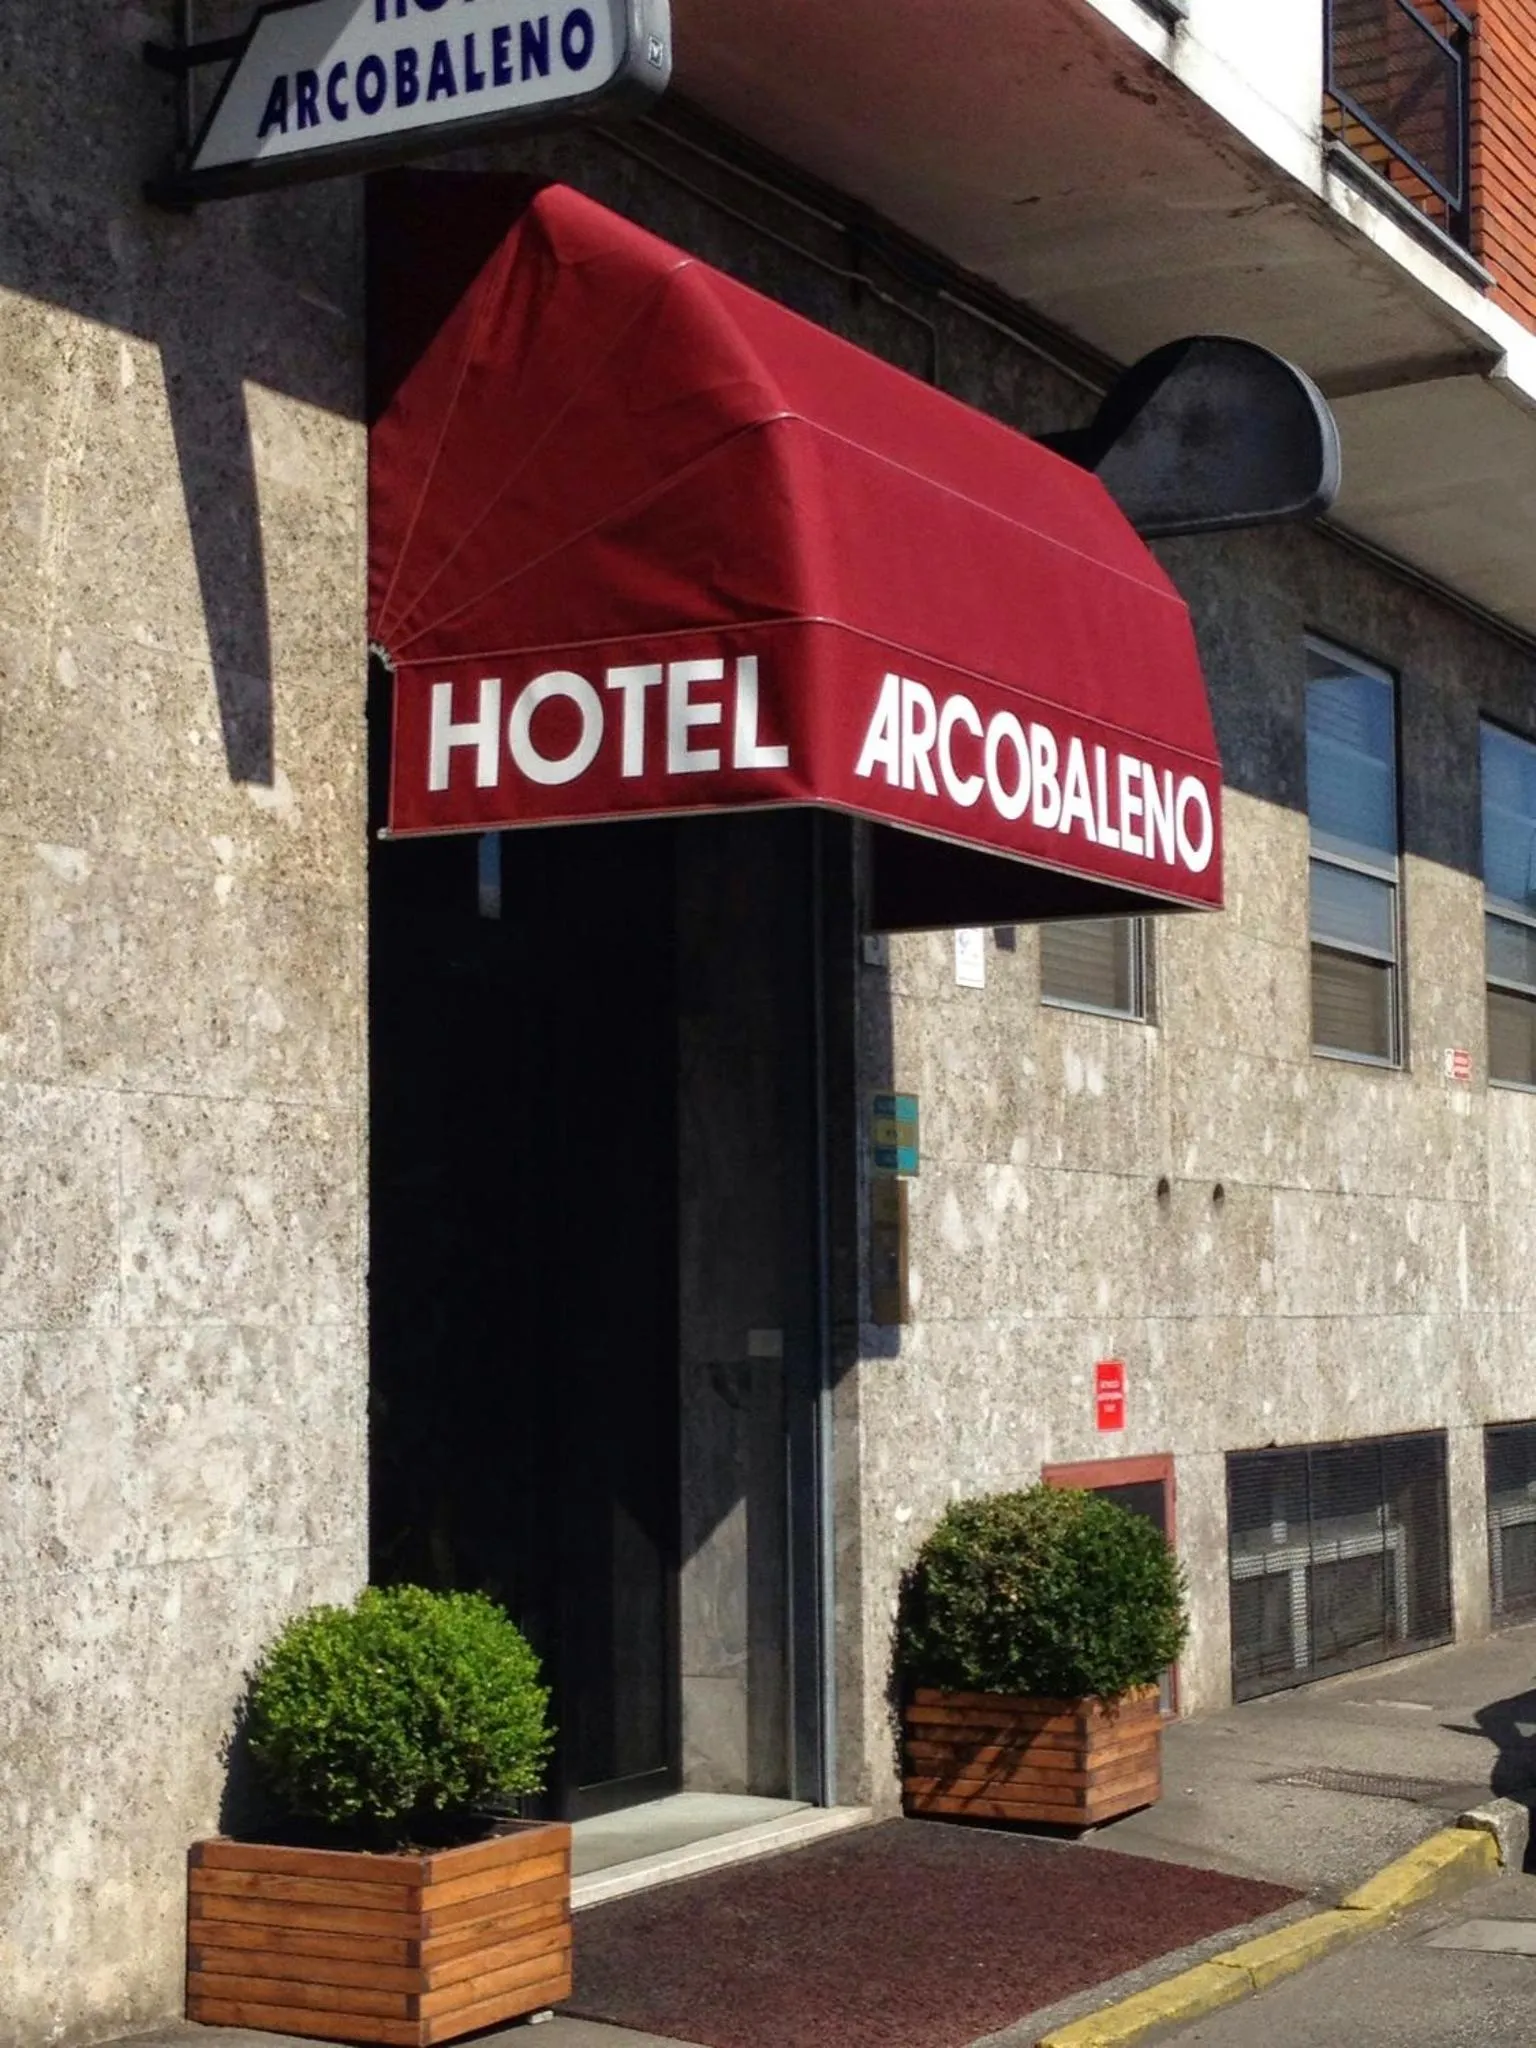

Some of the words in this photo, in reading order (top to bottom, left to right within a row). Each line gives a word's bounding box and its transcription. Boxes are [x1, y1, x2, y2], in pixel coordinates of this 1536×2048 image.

[257, 8, 595, 138] ARCOBALENO
[428, 655, 789, 792] HOTEL
[854, 673, 1214, 873] ARCOBALENO
